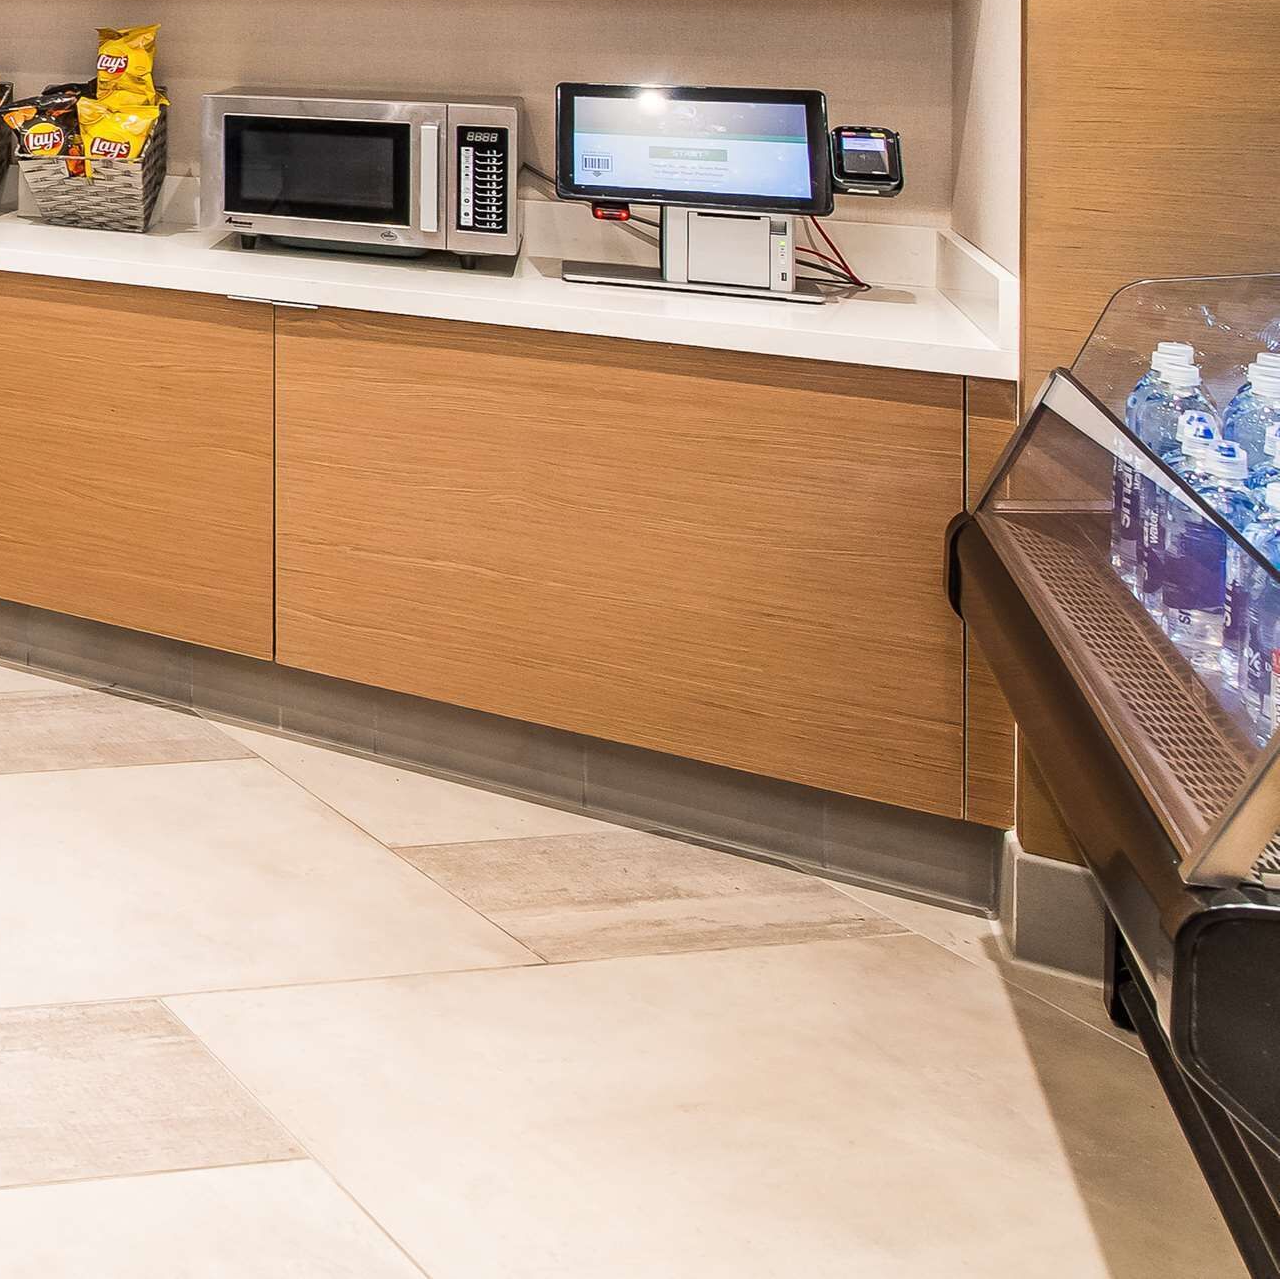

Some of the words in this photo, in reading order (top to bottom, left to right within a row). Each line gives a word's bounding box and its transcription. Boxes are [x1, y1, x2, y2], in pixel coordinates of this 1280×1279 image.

[97, 54, 127, 73] Lay's
[29, 131, 60, 150] Lay's
[92, 138, 129, 158] Lay's
